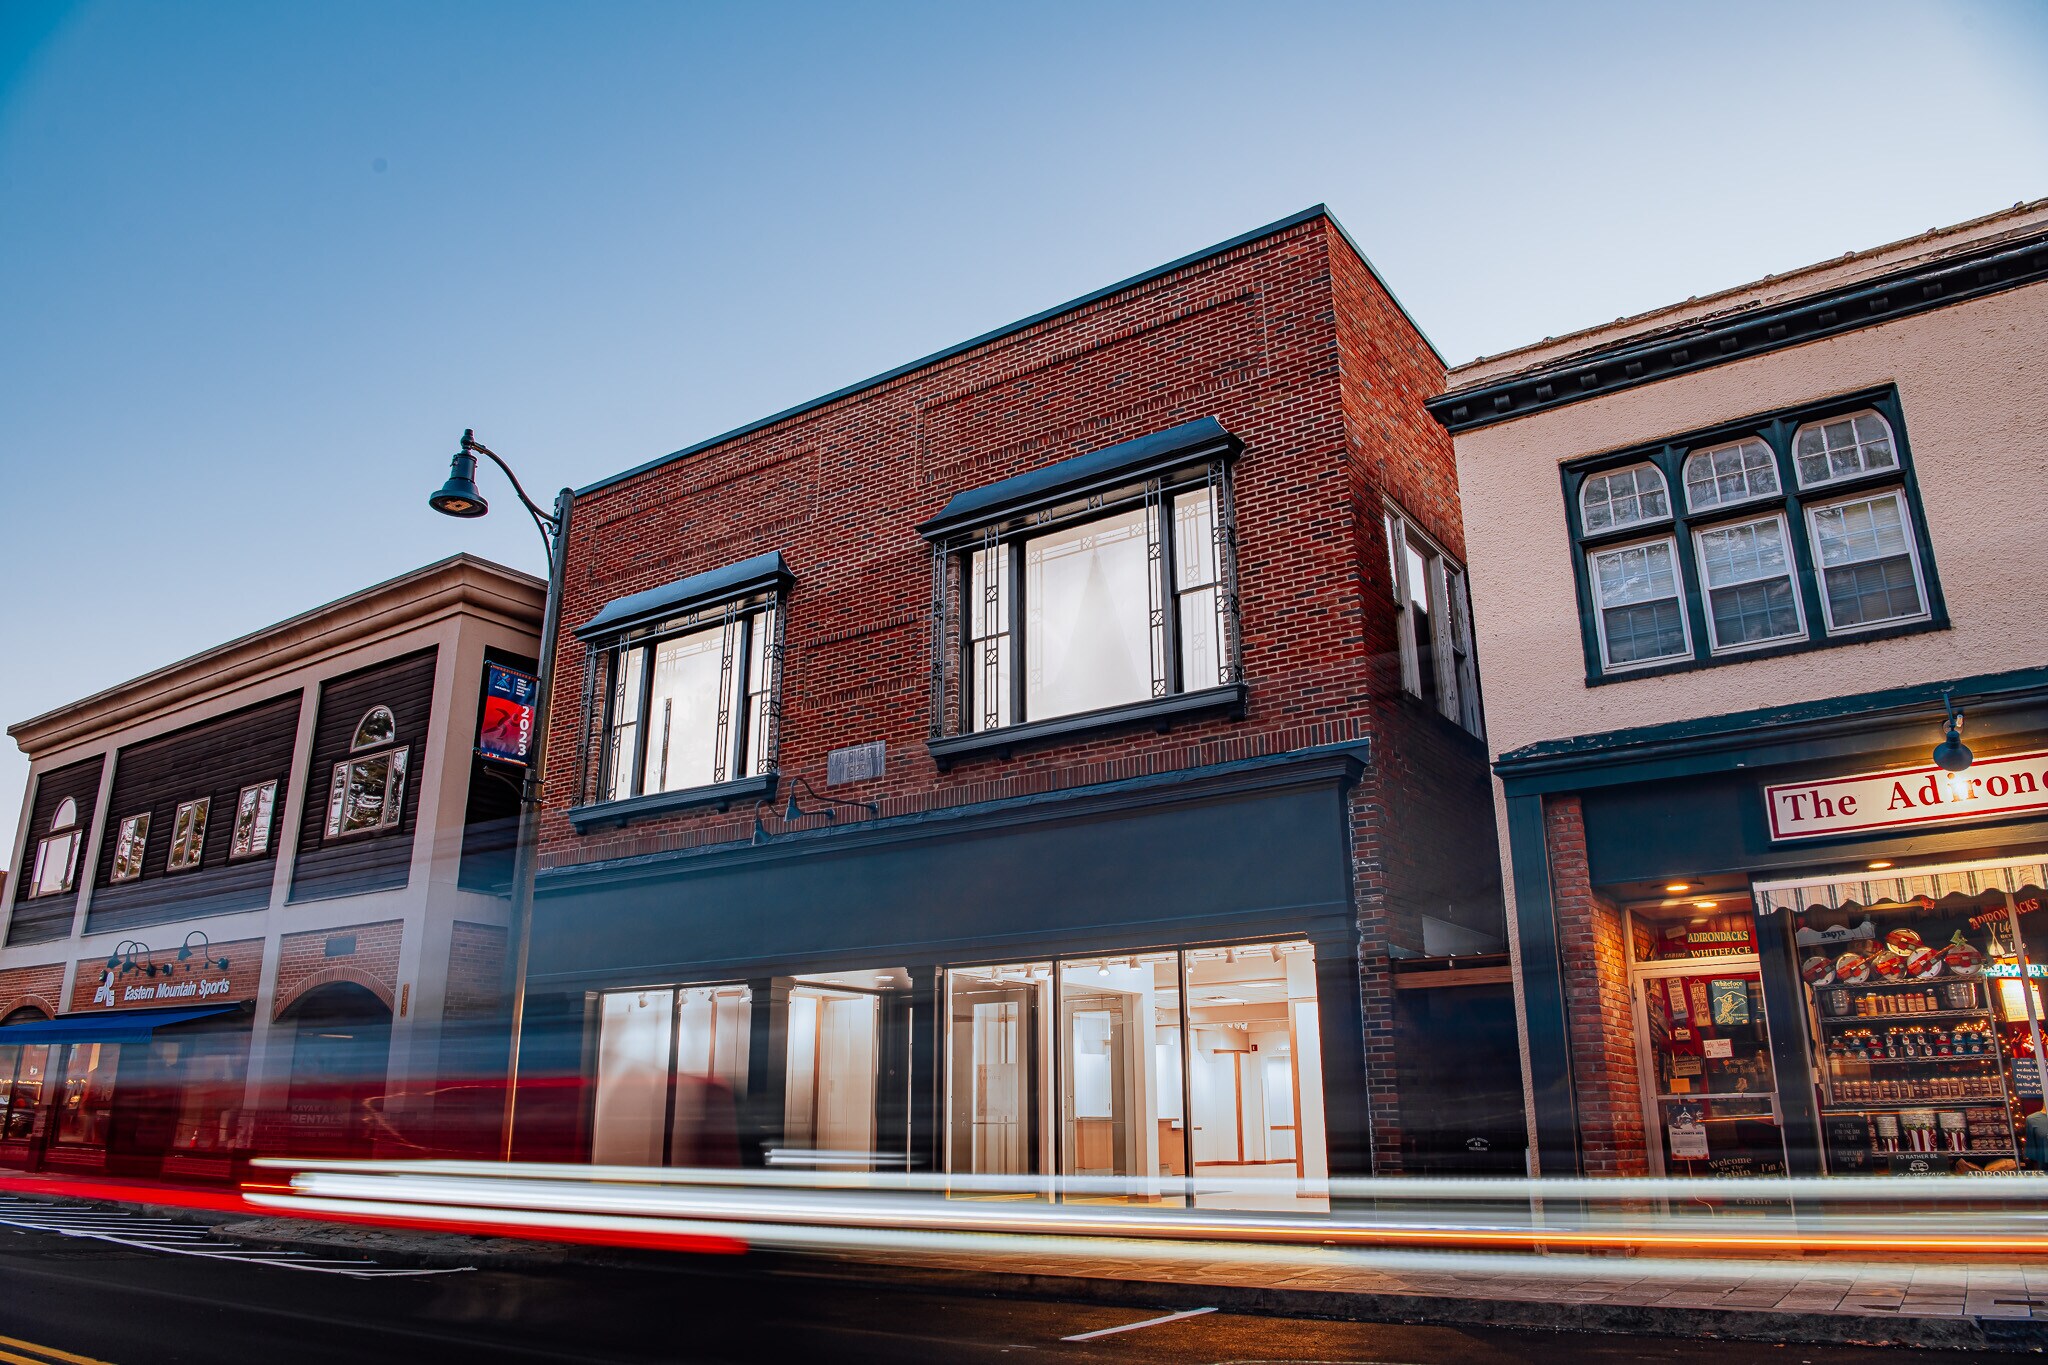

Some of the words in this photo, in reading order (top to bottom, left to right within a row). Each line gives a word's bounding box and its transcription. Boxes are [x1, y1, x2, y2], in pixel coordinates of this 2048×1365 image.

[517, 705, 530, 757] 2023
[1782, 789, 1858, 822] The
[1886, 771, 2048, 811] Adiron
[1970, 898, 2039, 929] ADIRONACKS
[1687, 930, 1749, 943] ADIRONDACKS
[1690, 946, 1752, 958] WHITEFACE
[124, 986, 154, 1000] Eastern
[156, 981, 197, 999] Mountain
[199, 978, 230, 999] Sports
[291, 1104, 319, 1112] KAYAK
[290, 1114, 344, 1125] RENTALS
[1709, 1157, 1752, 1169] Welcome
[1761, 1162, 1776, 1172] I'm
[1716, 1169, 1752, 1178] Cabin
